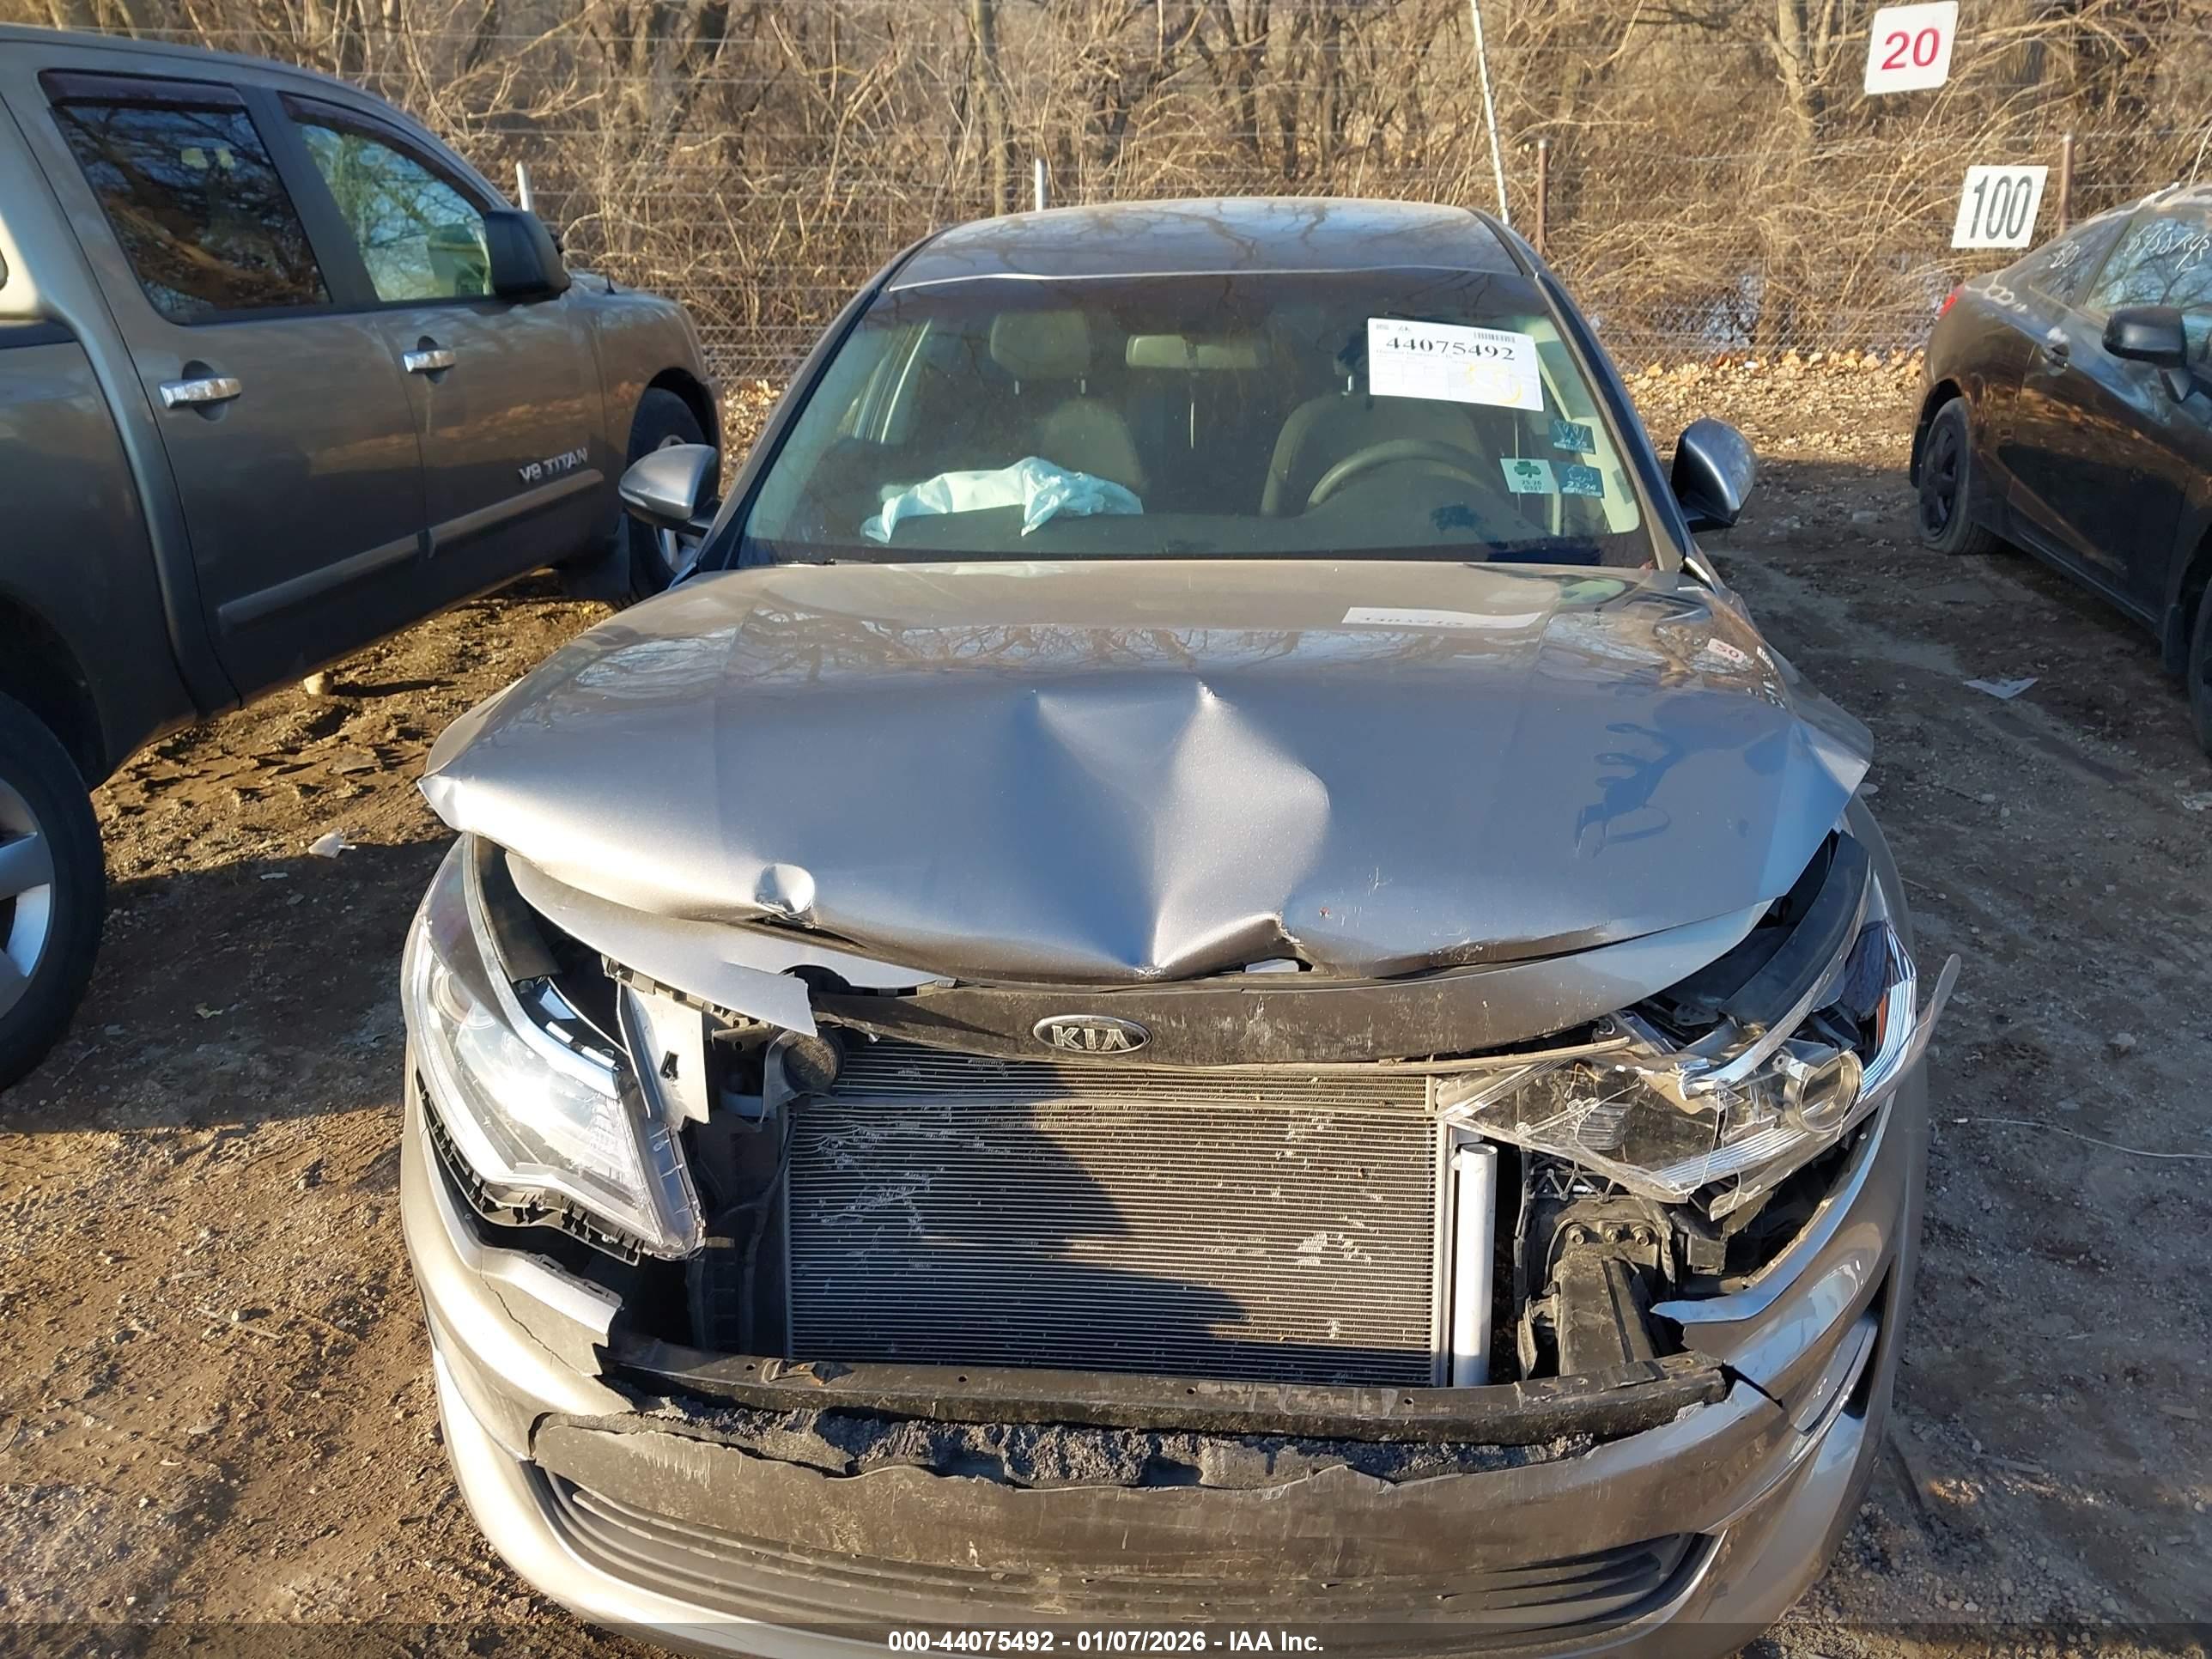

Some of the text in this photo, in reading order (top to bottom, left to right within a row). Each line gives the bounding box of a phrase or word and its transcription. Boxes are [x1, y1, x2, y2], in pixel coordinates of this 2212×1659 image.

[1881, 27, 1940, 70] 20
[1969, 174, 2033, 240] 100
[1386, 337, 1516, 361] 44075492
[543, 447, 588, 475] TITAN
[1051, 1024, 1132, 1051] KIA
